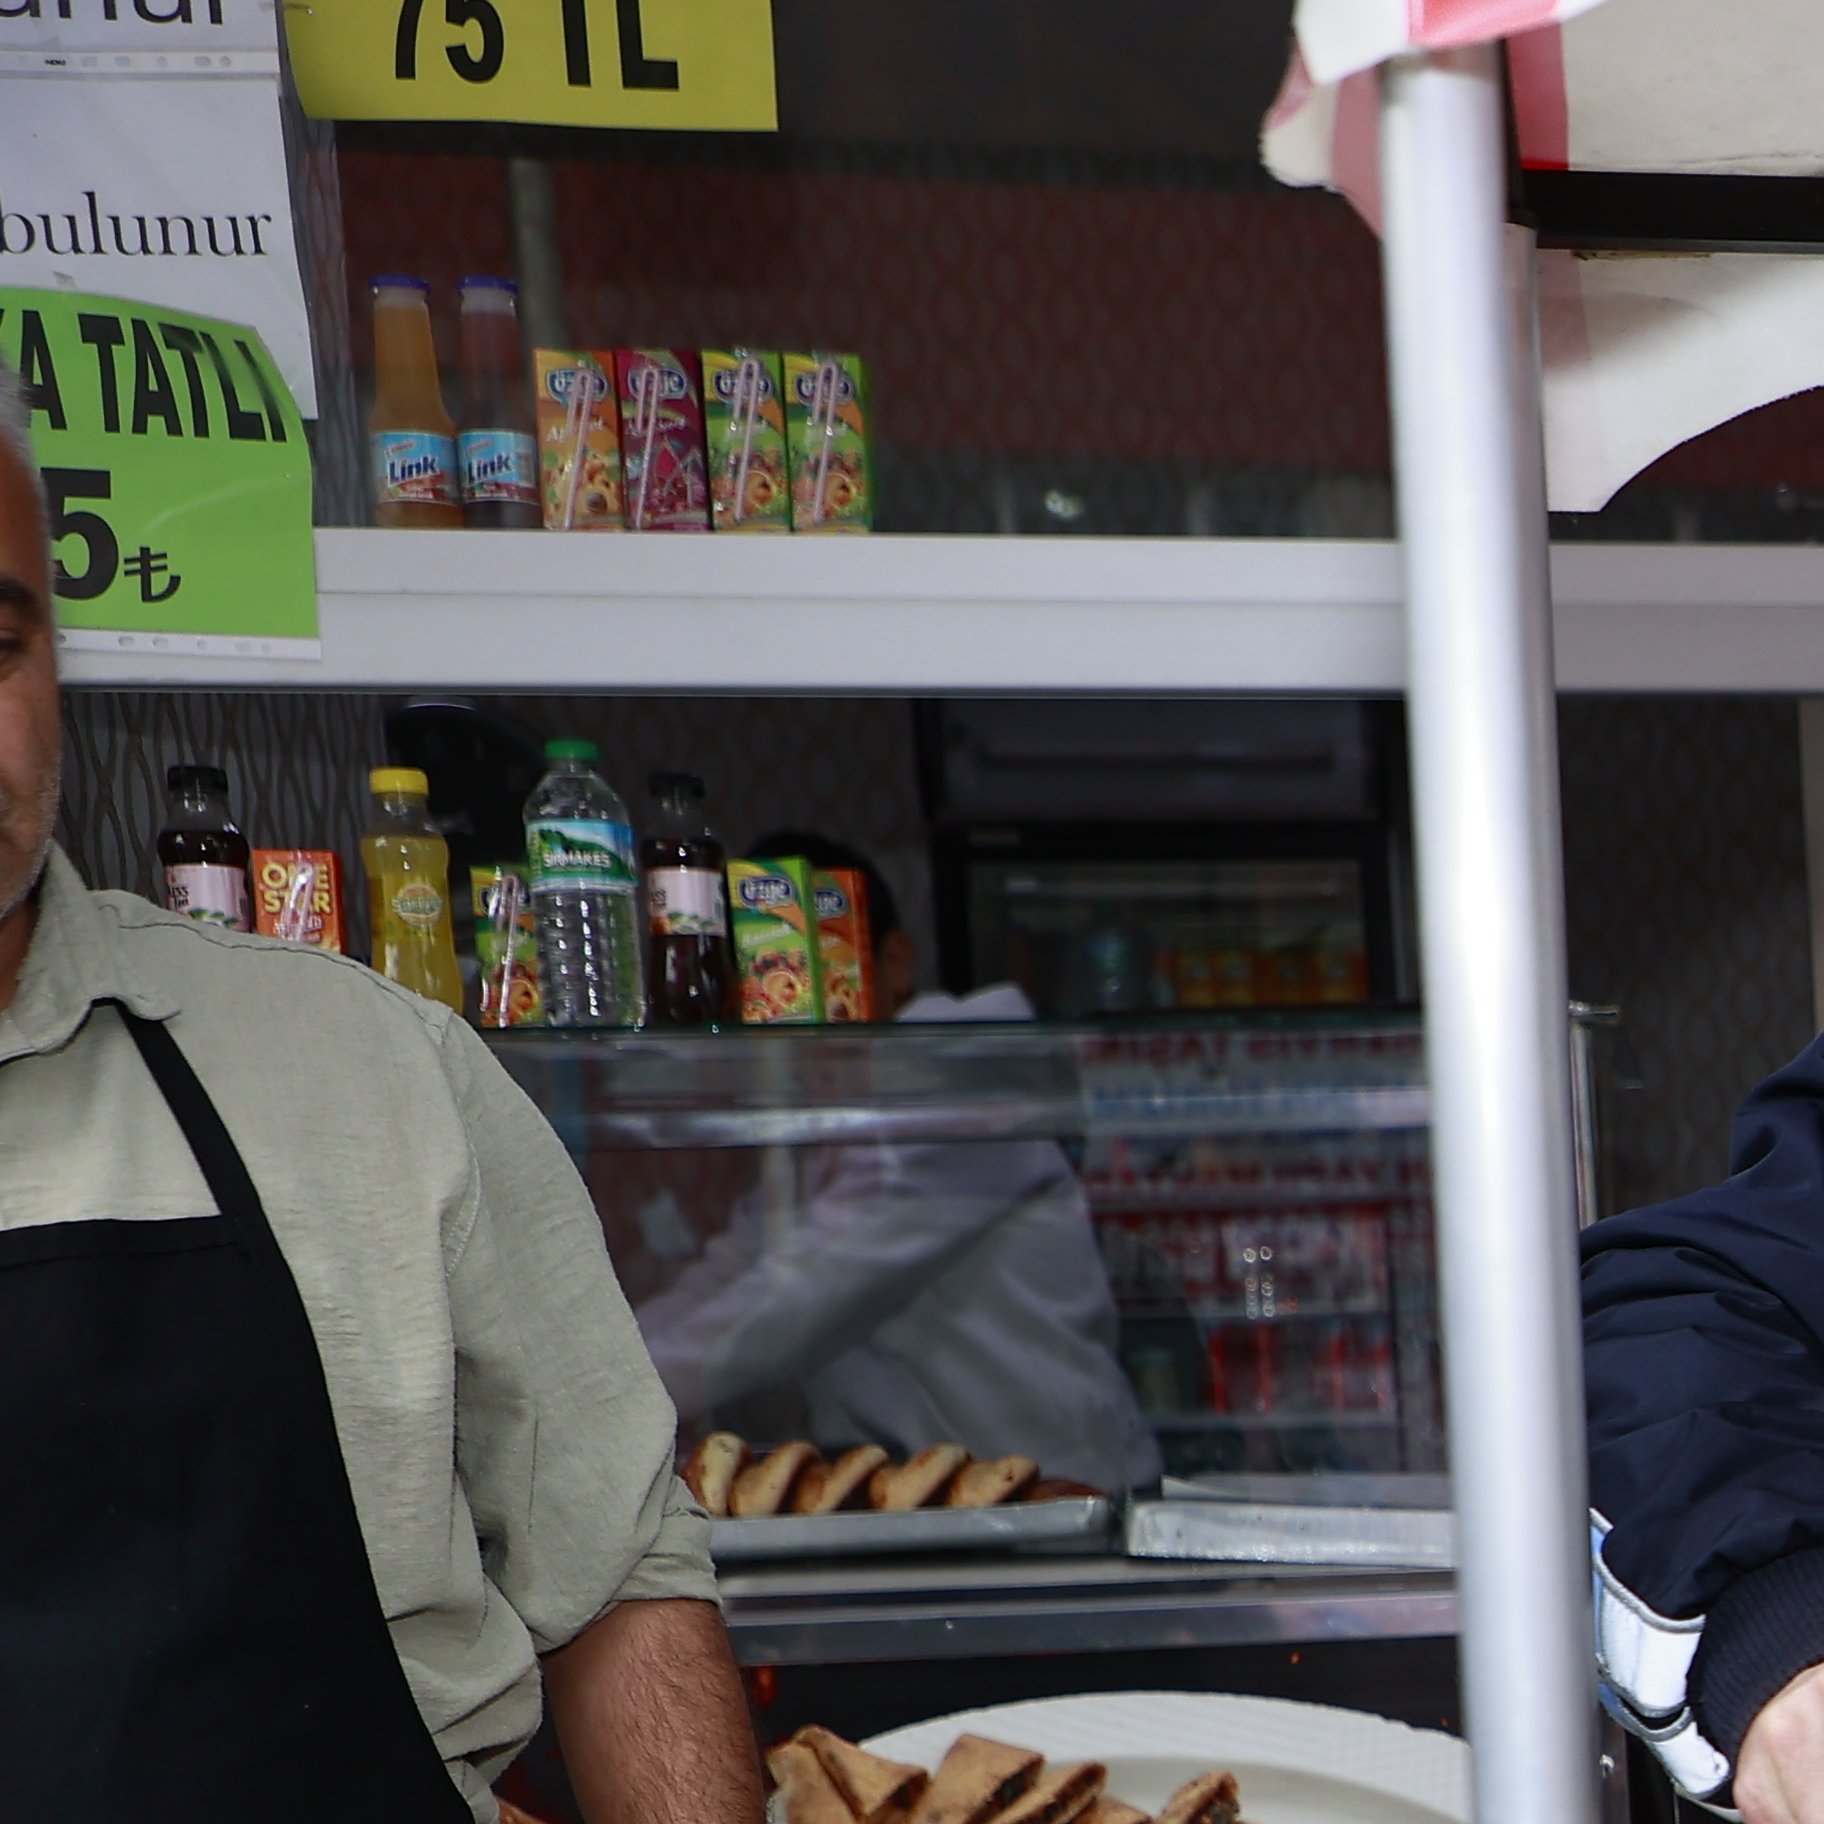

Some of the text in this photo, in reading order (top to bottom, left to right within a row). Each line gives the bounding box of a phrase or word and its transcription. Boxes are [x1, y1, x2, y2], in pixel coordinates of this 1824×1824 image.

[0, 191, 272, 257] bulunur
[0, 308, 288, 443] A TATLI
[387, 455, 439, 487] Link
[466, 453, 513, 485] Link
